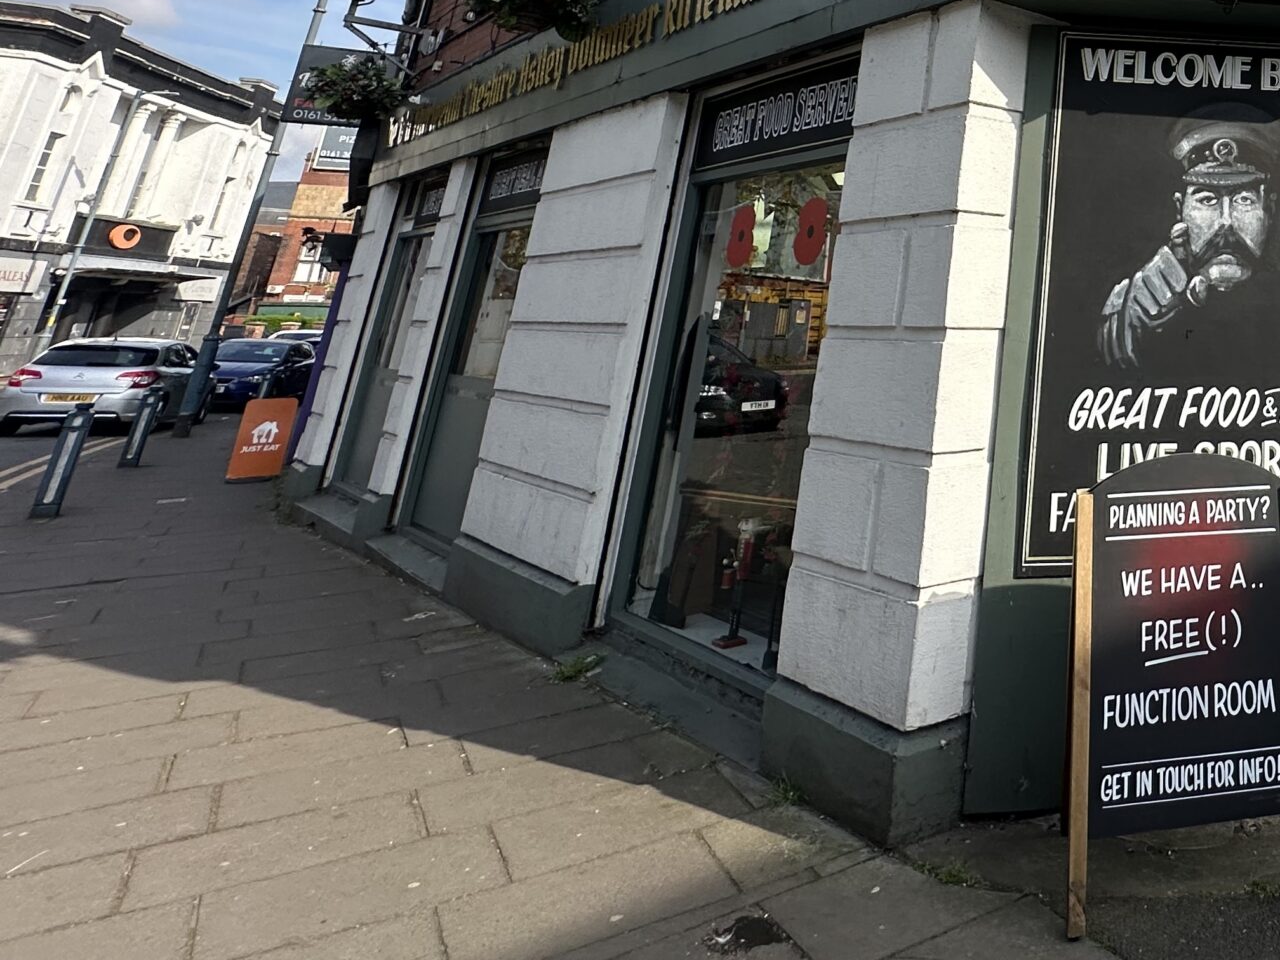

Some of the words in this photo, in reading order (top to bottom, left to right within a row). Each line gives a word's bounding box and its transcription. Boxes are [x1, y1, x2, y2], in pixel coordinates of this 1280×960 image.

[1081, 47, 1253, 90] WELCOME
[292, 109, 320, 119] 0161
[712, 101, 757, 152] GREAT
[753, 92, 794, 141] FOOD
[792, 75, 858, 132] SERVED
[0, 270, 29, 282] ALEAS
[1068, 386, 1177, 432] GREAT
[1178, 386, 1260, 429] FOOD
[1262, 397, 1278, 419] &
[240, 445, 262, 454] JUST
[263, 444, 281, 452] EAT
[1109, 501, 1186, 530] PLANNING
[1188, 500, 1200, 525] A
[1206, 495, 1271, 524] PARTY?
[1122, 568, 1153, 597] WE
[1161, 563, 1221, 593] HAVE
[1102, 684, 1210, 731] FUNCTION
[1215, 679, 1276, 715] ROOM
[1100, 771, 1132, 804] GET
[1136, 768, 1154, 798] IN
[1156, 762, 1204, 794] TOUCH
[1207, 758, 1236, 789] FOR
